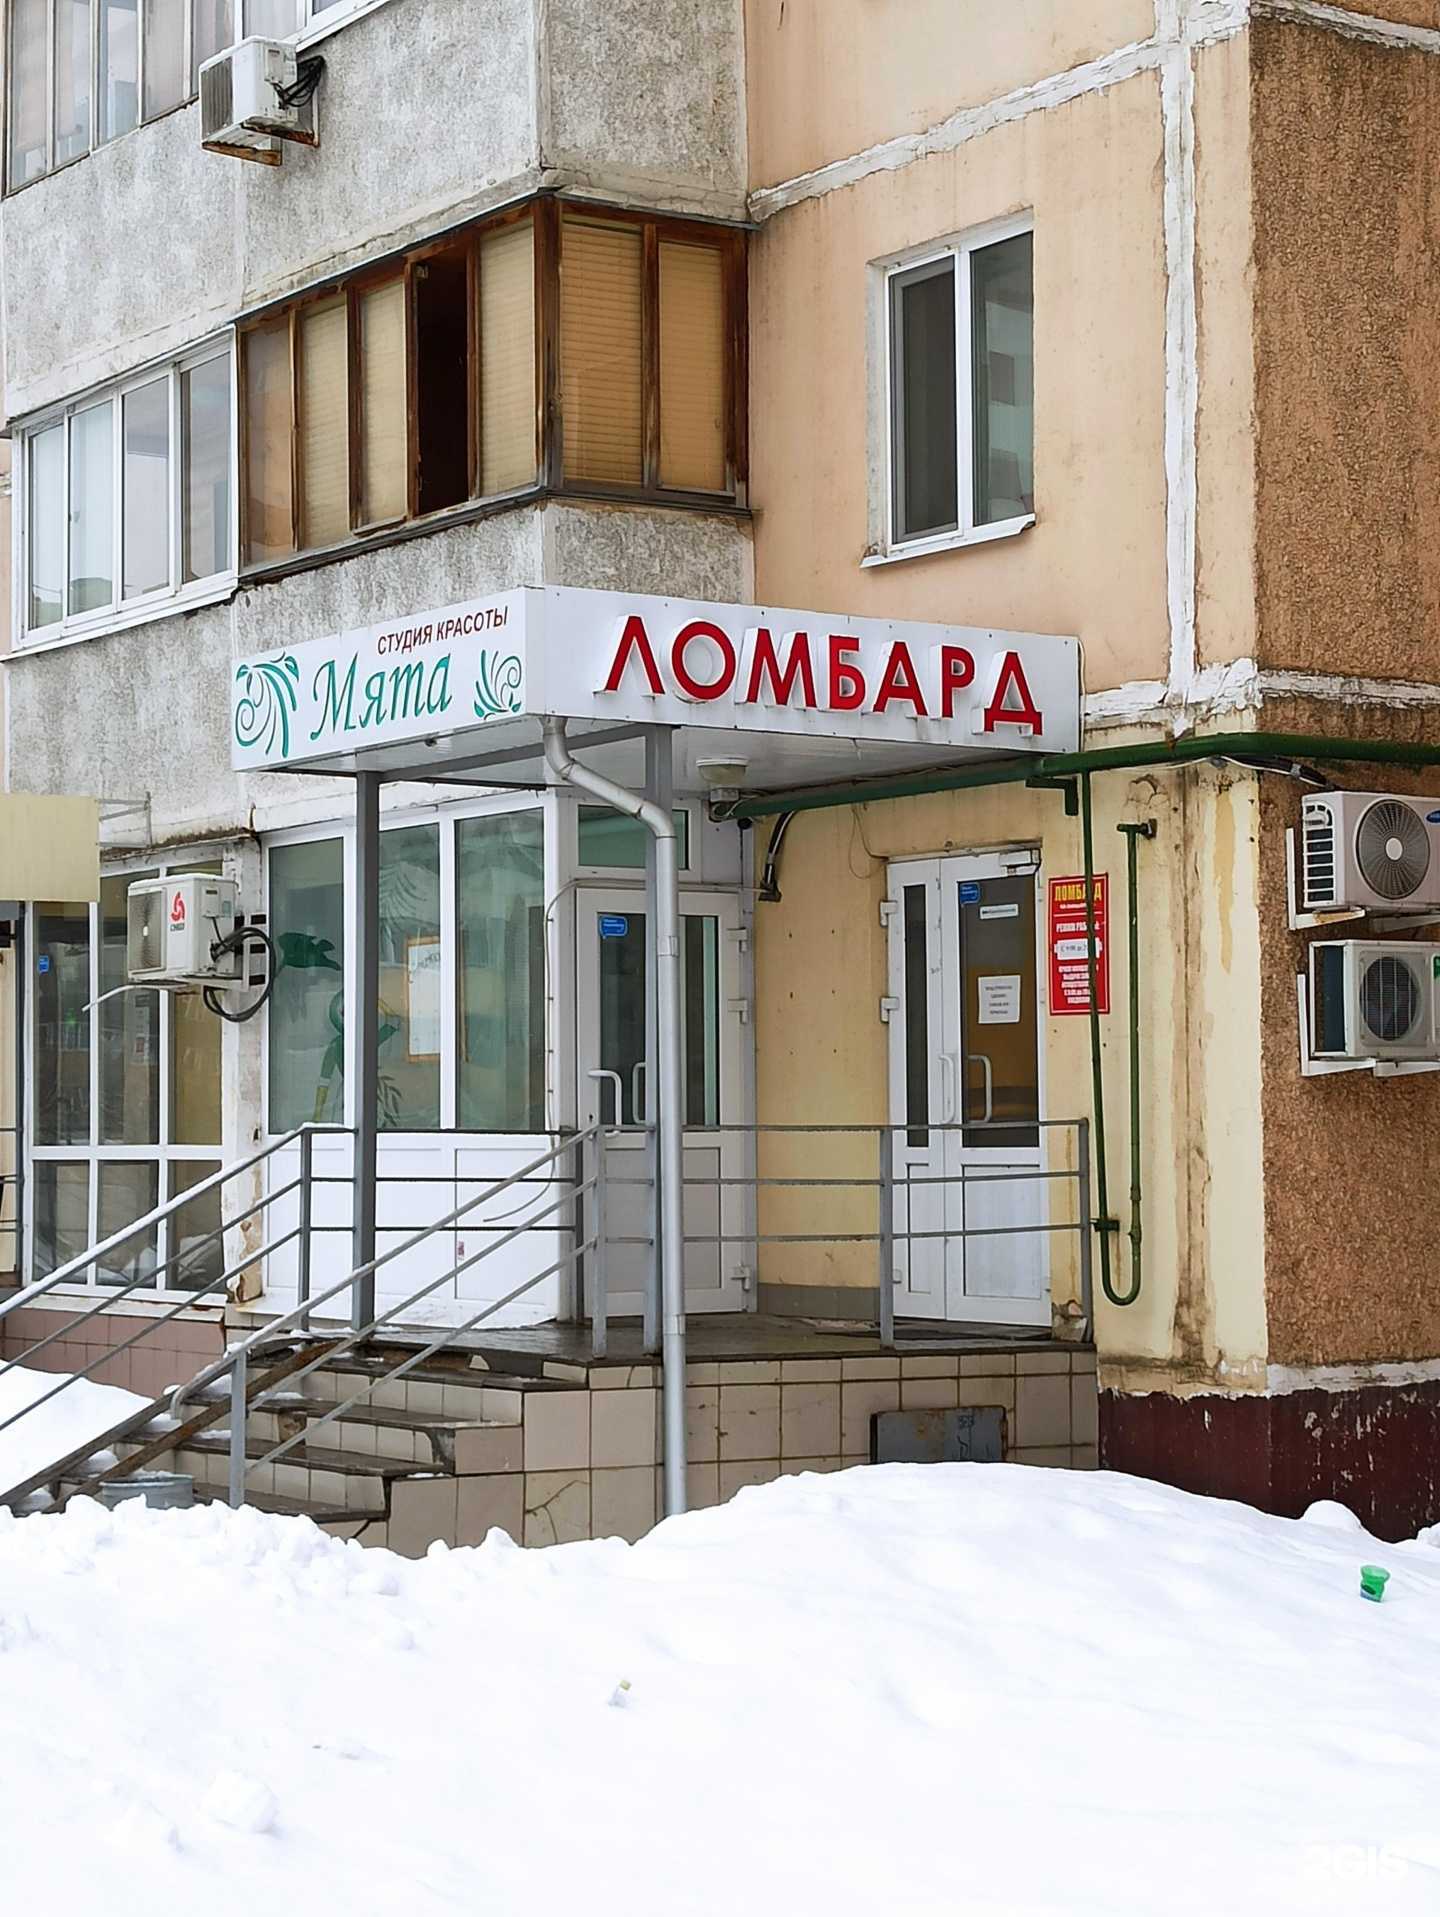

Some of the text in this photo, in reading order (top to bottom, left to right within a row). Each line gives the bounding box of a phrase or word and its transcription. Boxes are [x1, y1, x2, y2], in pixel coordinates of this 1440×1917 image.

[377, 605, 508, 655] СТУДИЯ КРАСОТЫ
[309, 651, 452, 741] Мята
[603, 615, 1043, 736] ЛОМБАРД
[1055, 882, 1102, 901] ЛОМБД
